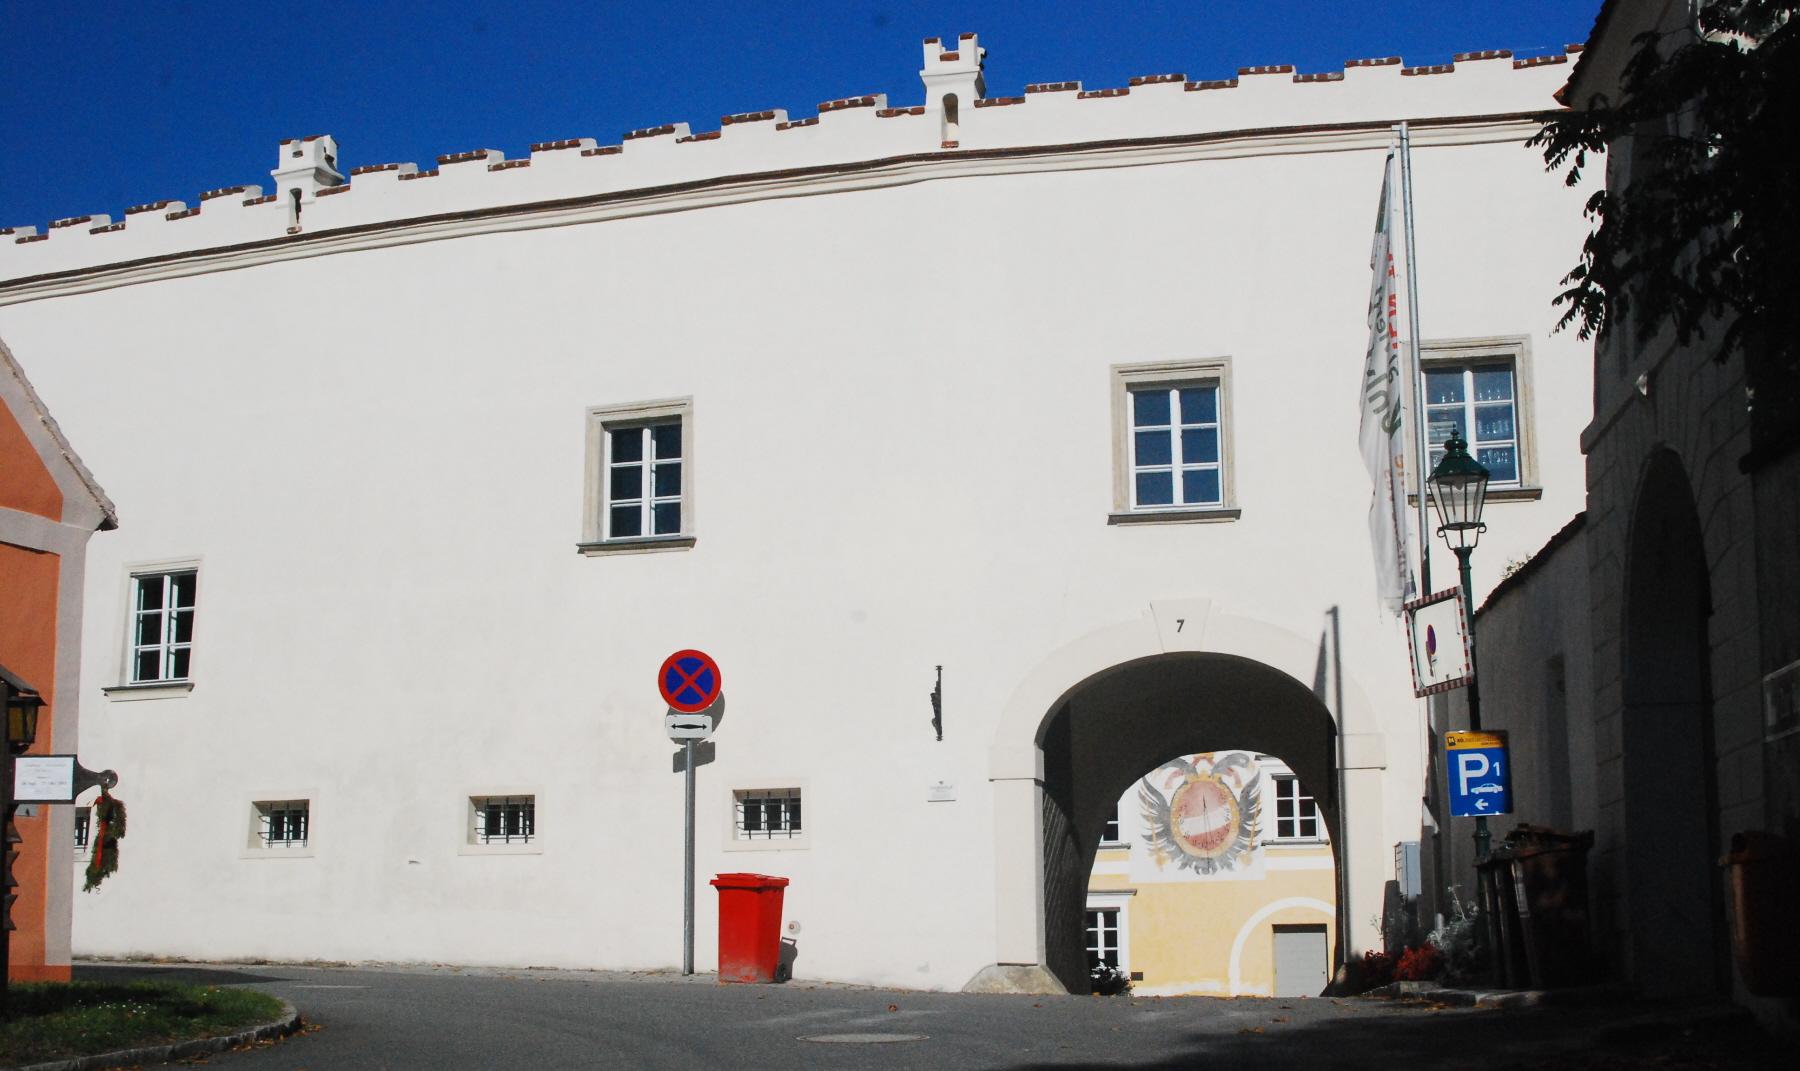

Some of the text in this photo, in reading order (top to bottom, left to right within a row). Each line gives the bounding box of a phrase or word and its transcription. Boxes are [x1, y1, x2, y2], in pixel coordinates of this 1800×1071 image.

[1177, 619, 1185, 633] 7
[1458, 753, 1501, 796] P 1
